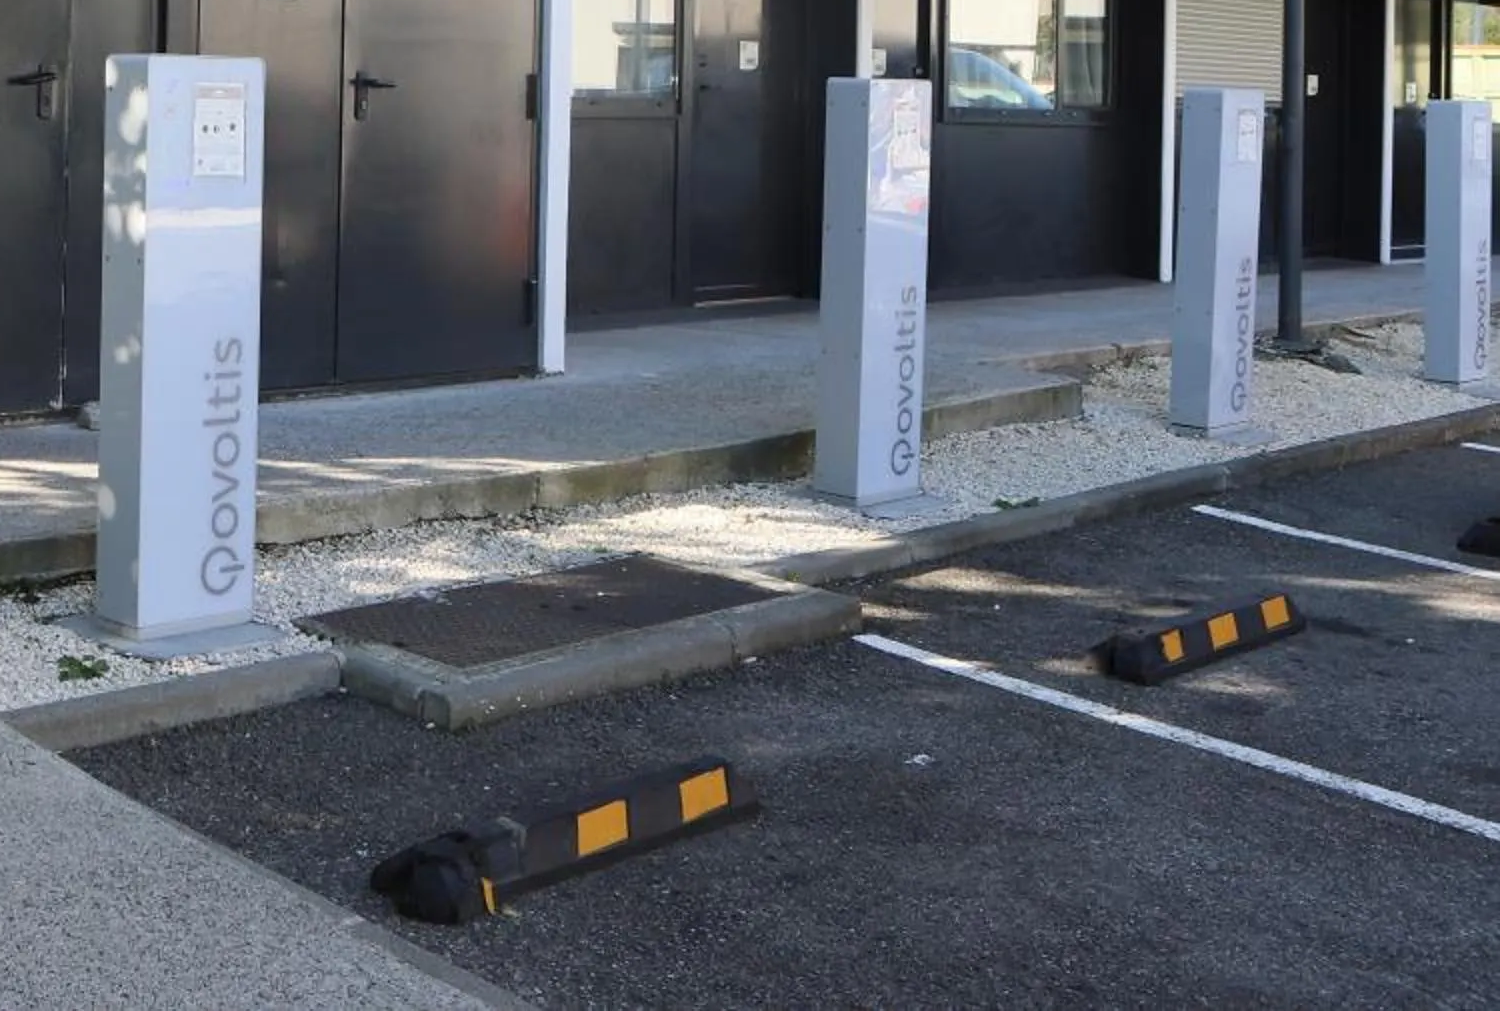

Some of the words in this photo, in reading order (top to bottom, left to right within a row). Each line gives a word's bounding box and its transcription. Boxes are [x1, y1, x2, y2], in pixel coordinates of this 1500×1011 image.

[890, 284, 918, 476] Qovoltis
[1230, 256, 1253, 414] Qovoltis
[200, 336, 246, 596] Qovoltis
